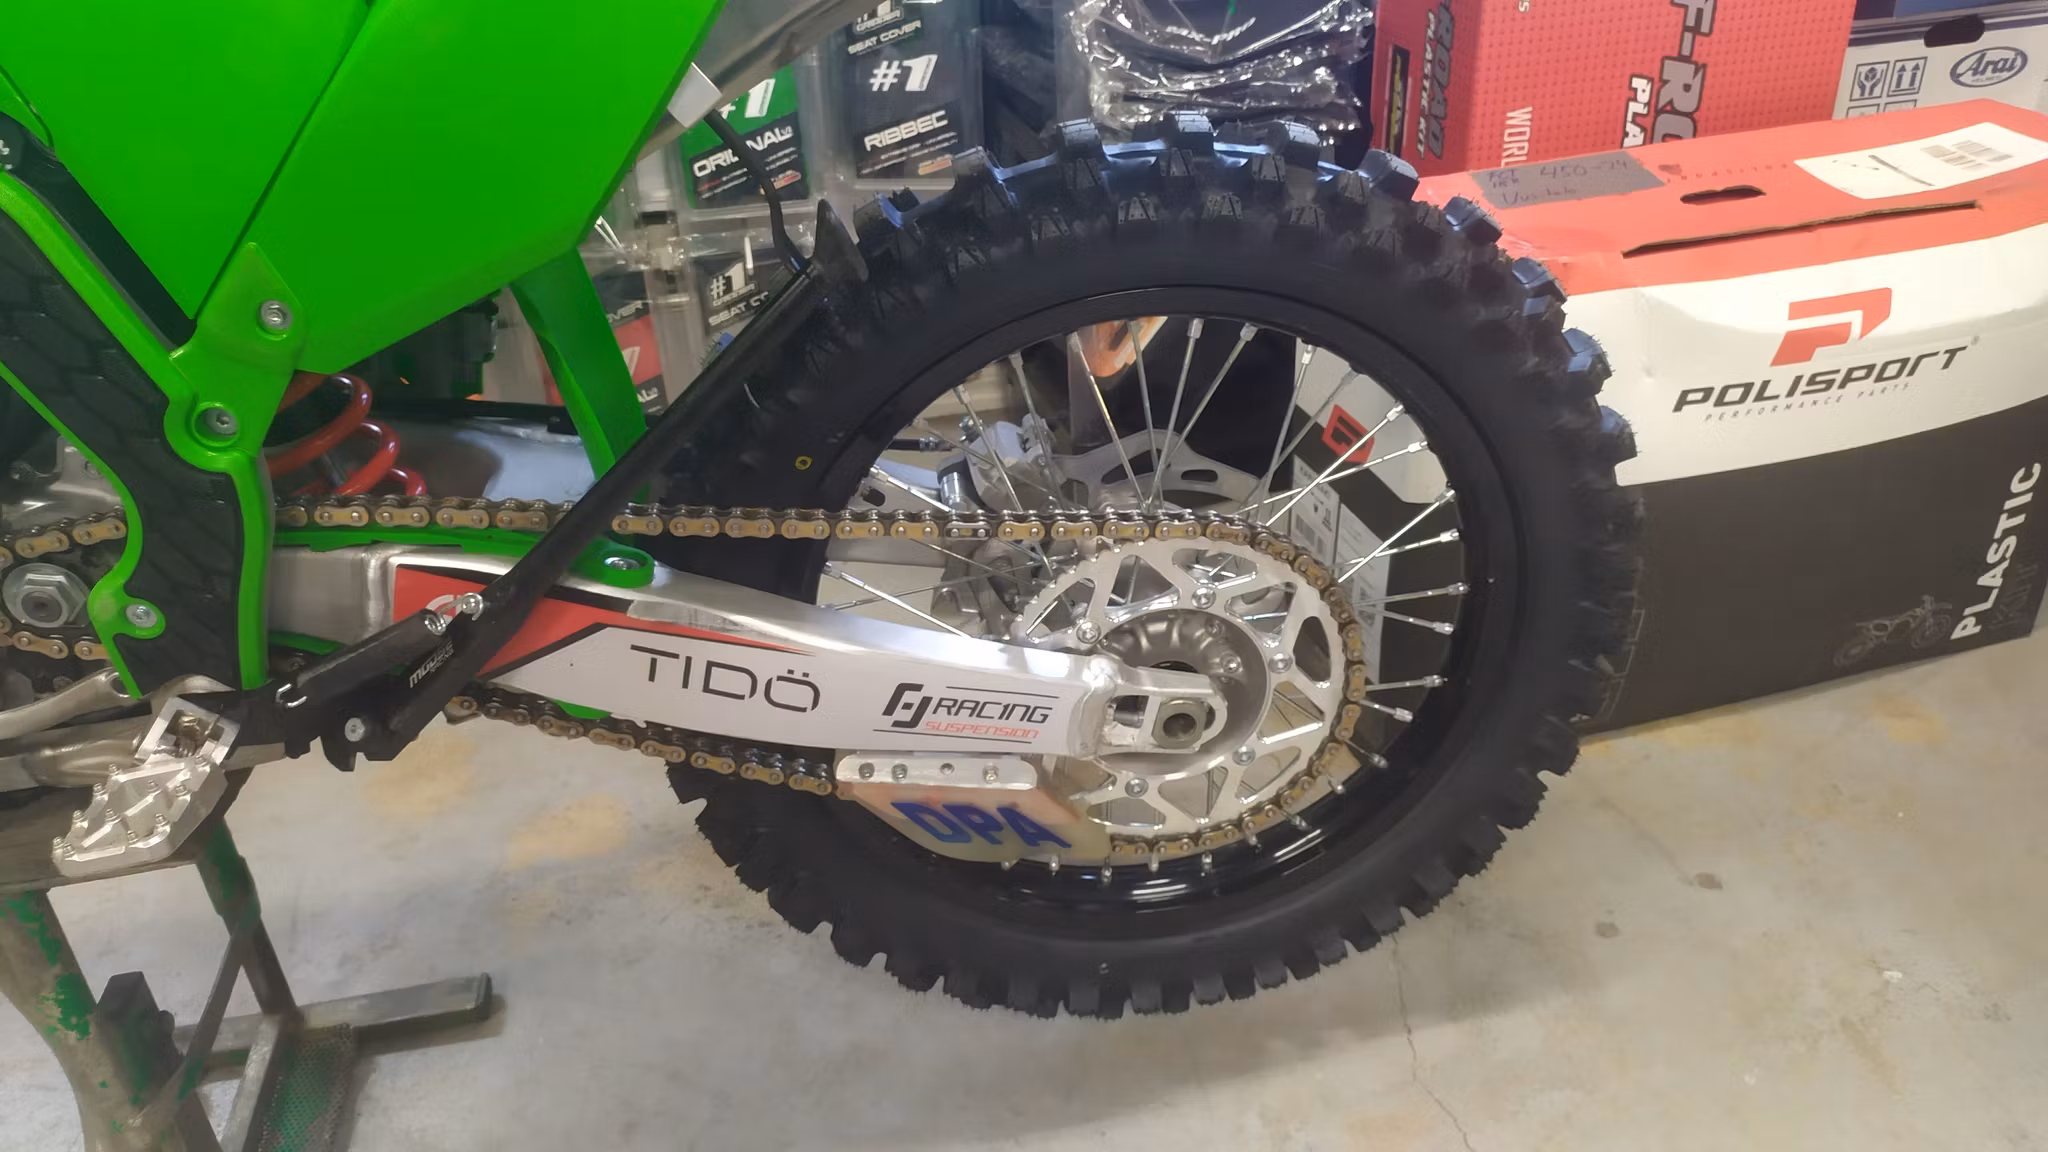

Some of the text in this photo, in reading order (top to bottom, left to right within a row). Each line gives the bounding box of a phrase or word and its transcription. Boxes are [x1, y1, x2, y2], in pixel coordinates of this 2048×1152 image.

[848, 19, 922, 54] SEAT COVER
[869, 54, 938, 92] #1
[1420, 11, 1436, 115] PLASTIC
[1429, 0, 1455, 158] ROAD
[1955, 52, 2020, 78] Arai
[693, 126, 793, 177] ORINAL
[864, 110, 949, 152] RIBBEC
[710, 261, 746, 300] #1
[708, 302, 747, 326] SEAT
[1672, 346, 1968, 413] POLISPORT
[1704, 382, 1911, 422] PERFORMANCE PARTS
[1950, 463, 2041, 640] PLASTIC
[630, 644, 821, 713] TIDÖ
[925, 720, 1040, 739] SUSPENSION
[932, 697, 1053, 724] RACING
[890, 802, 1073, 848] DPA
